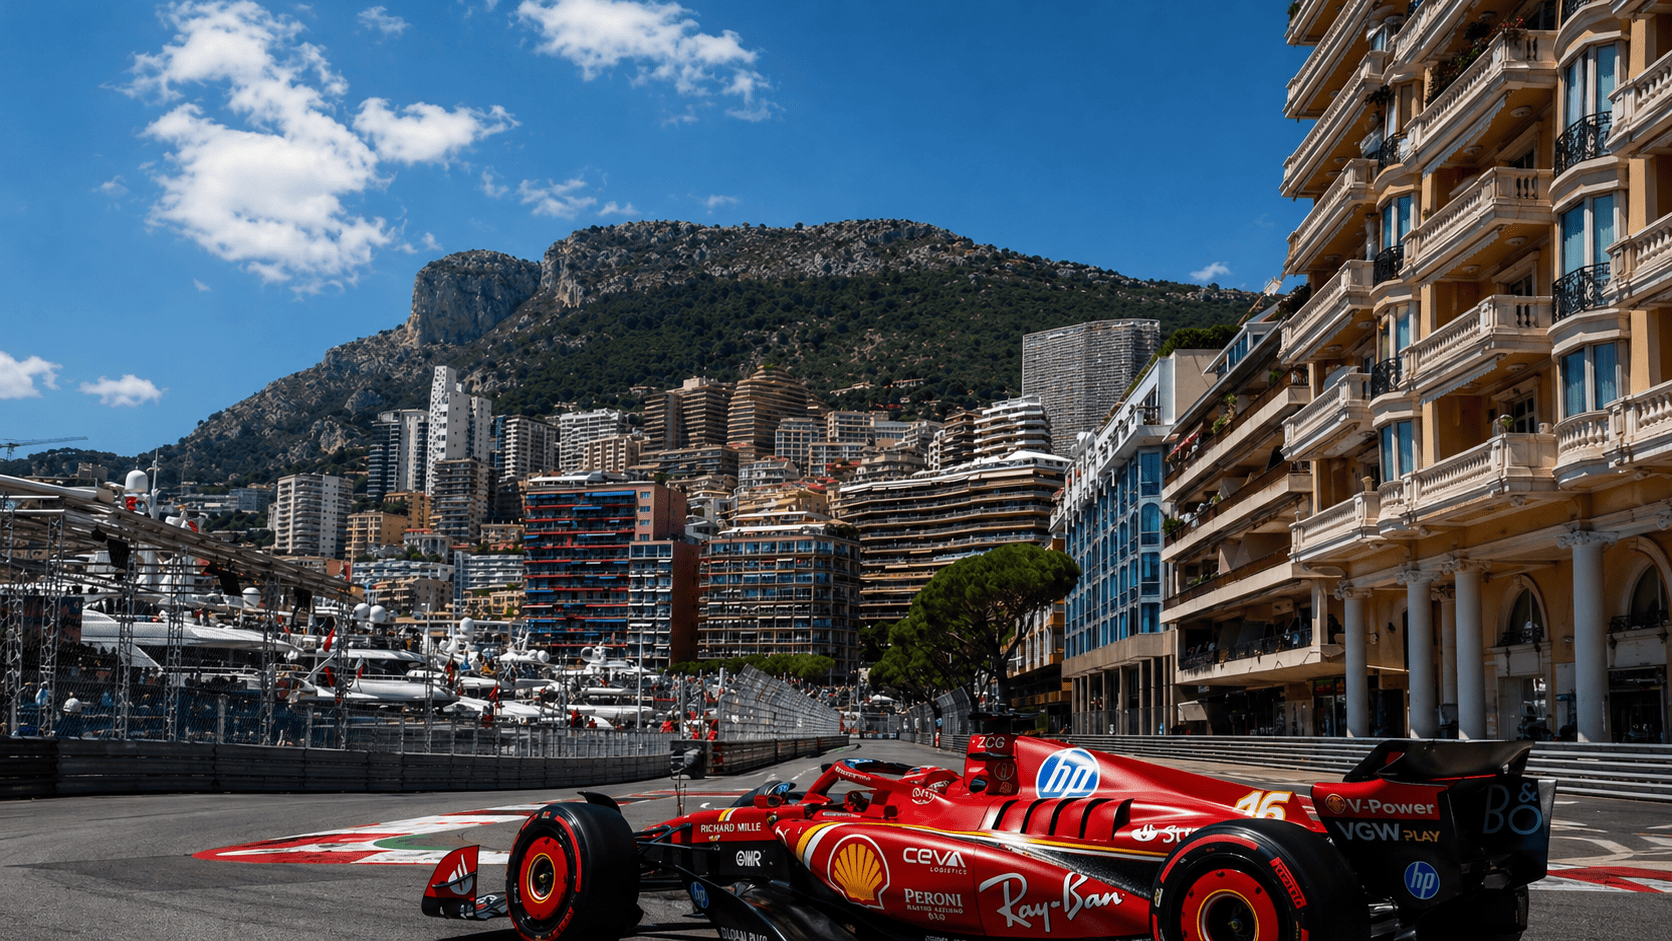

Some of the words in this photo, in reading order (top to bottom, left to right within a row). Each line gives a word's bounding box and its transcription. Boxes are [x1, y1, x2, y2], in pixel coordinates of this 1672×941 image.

[977, 736, 1005, 748] ZCG
[1042, 748, 1094, 798] hp
[1346, 798, 1435, 815] V-Power
[701, 824, 735, 833] RICHARD
[737, 822, 761, 832] MILLE
[1336, 821, 1400, 841] VGW
[1403, 830, 1440, 842] PLAY
[930, 867, 967, 875] LOGISTICS
[1410, 861, 1435, 899] hp
[904, 888, 963, 907] PERONI
[979, 871, 1123, 933] Ray-Ban
